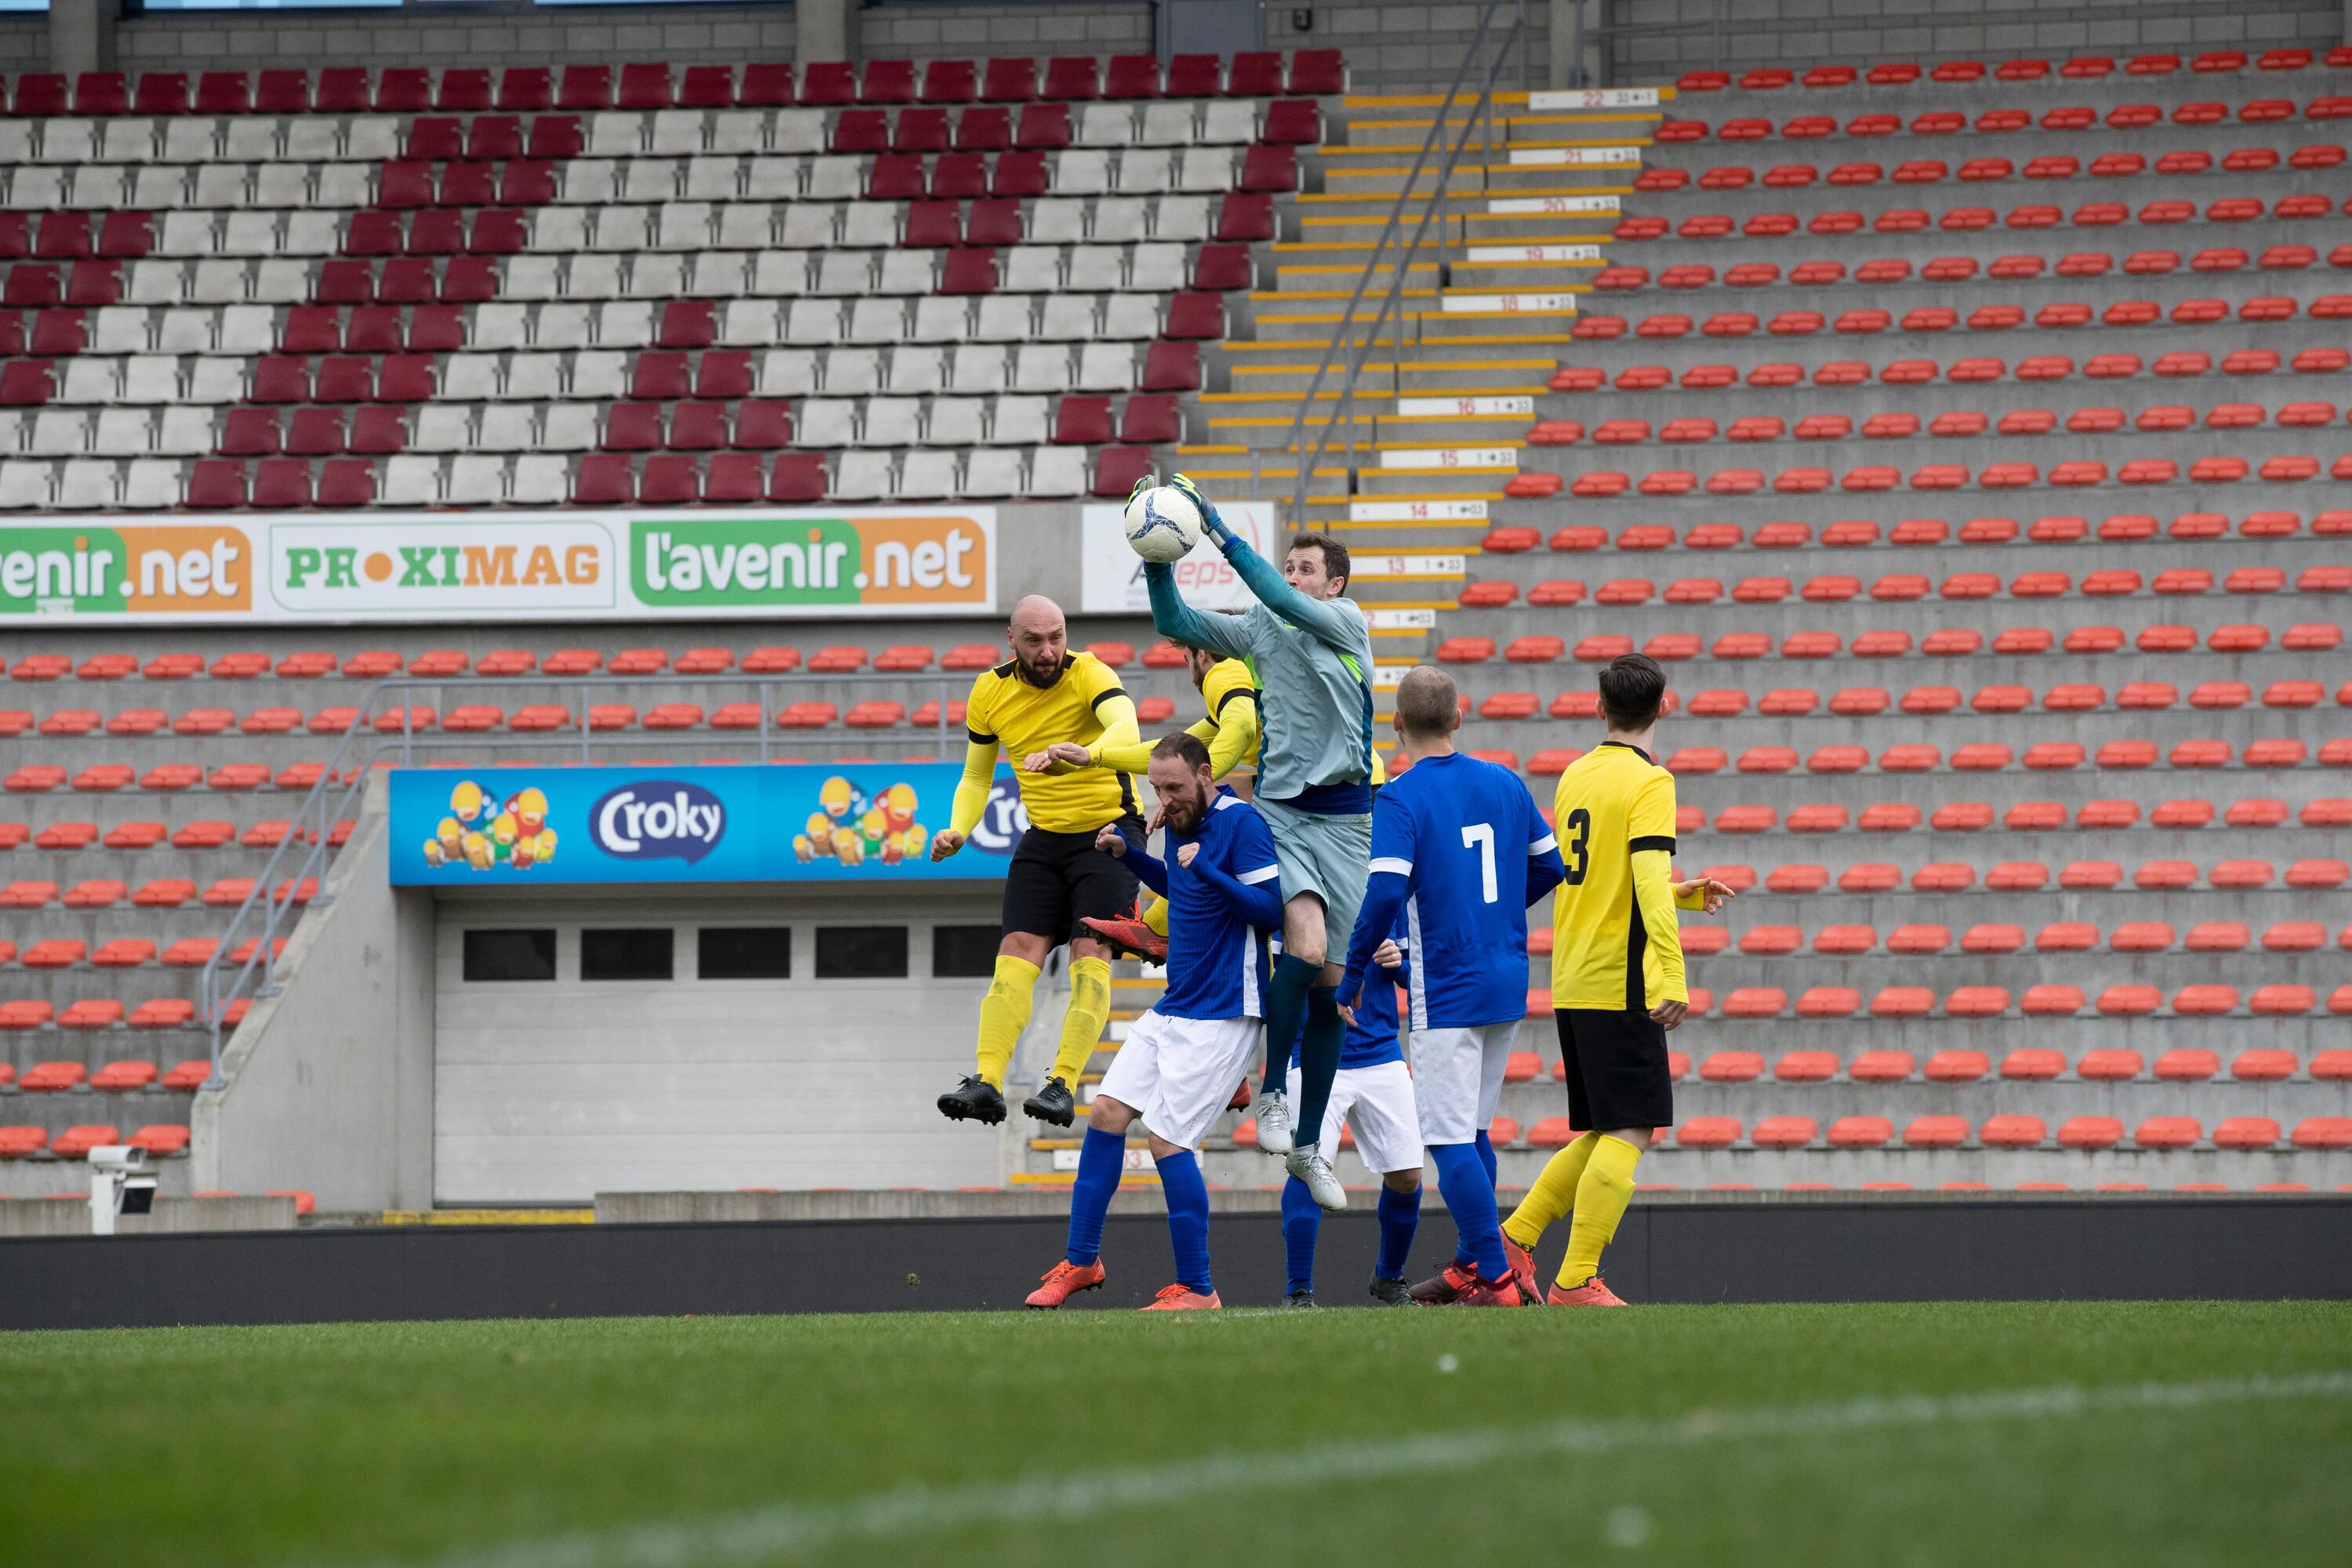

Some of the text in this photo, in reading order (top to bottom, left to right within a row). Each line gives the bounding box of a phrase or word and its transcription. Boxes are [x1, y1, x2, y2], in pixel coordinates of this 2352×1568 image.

[1583, 90, 1605, 107] 22
[1564, 149, 1582, 163] 21
[1544, 198, 1566, 212] 20
[1526, 246, 1544, 261] 19
[1457, 398, 1475, 414] 16
[1440, 451, 1458, 466] 15
[1410, 502, 1428, 519] 14
[0, 535, 238, 598] enir.net
[285, 544, 600, 589] PROXIMAG
[644, 527, 974, 591] l'avenir.net
[1388, 557, 1406, 575] 13
[599, 790, 721, 852] Croky
[1565, 808, 1591, 885] 3
[1461, 823, 1498, 904] 7
